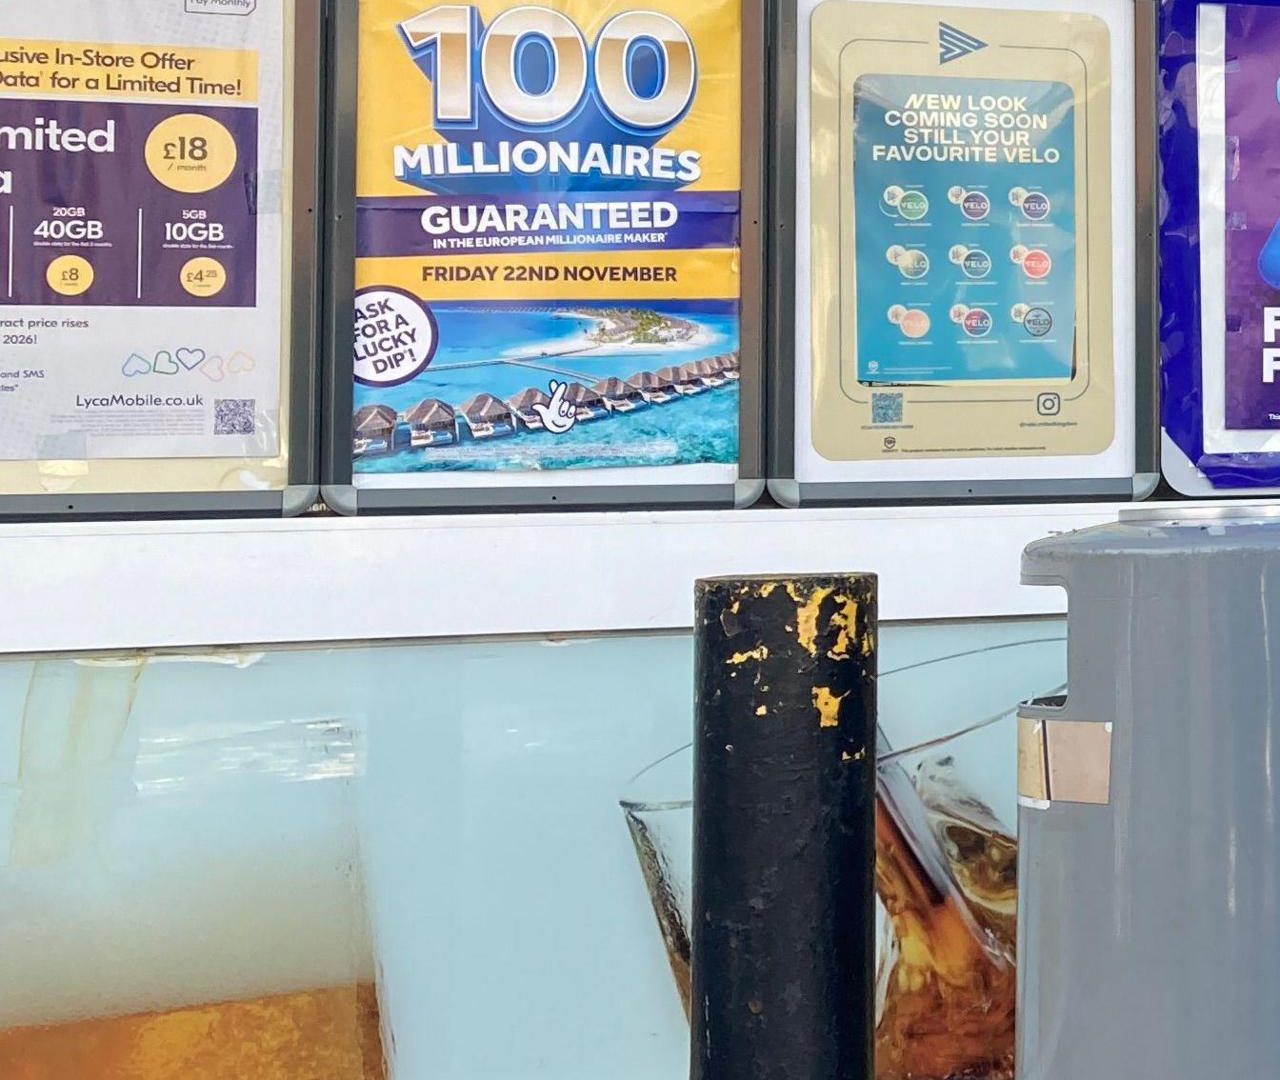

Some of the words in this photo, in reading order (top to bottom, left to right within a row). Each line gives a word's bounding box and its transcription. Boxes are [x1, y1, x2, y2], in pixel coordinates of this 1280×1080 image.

[55, 47, 135, 69] In-Store
[140, 51, 196, 72] Offer
[397, 3, 699, 130] 100
[50, 71, 81, 90] for
[85, 77, 100, 91] a
[105, 73, 182, 95] Limited
[186, 76, 243, 97] Time!
[905, 93, 961, 111] NEW
[968, 95, 1029, 112] LOOK
[884, 109, 978, 129] COMING
[983, 111, 1049, 130] SOON
[904, 128, 965, 146] STILL
[969, 130, 1030, 147] YOUR
[163, 135, 209, 162] £18
[872, 144, 998, 164] FAVOURITE
[1002, 147, 1061, 165] VELO
[393, 140, 702, 182] MILLIONAIRES
[52, 206, 87, 218] 20GB
[182, 209, 207, 221] 5GB
[963, 201, 989, 212] VELO
[1024, 201, 1050, 213] VELO
[420, 200, 680, 235] GUARANTEED
[33, 220, 104, 240] 40GB
[164, 223, 225, 242] 10GB
[433, 238, 446, 250] IN
[447, 237, 475, 249] THE
[476, 235, 544, 248] EUROPEAN
[545, 233, 623, 245] MILLIONAIRE
[624, 231, 668, 243] MAKER
[421, 265, 499, 283] FRIDAY
[503, 265, 560, 283] 22ND
[563, 265, 679, 283] NOVEMBER
[965, 259, 990, 270] VELO
[1026, 259, 1051, 270] VELO
[60, 268, 80, 282] £8
[354, 297, 396, 324] ASK
[27, 317, 59, 330] price
[61, 318, 90, 329] rises
[395, 311, 411, 330] A
[966, 319, 991, 329] VELO
[3, 334, 38, 346] 2026!
[353, 327, 419, 362] LUCKY
[22, 370, 45, 380] SMS
[75, 393, 204, 410] LycaMobile.co.uk
